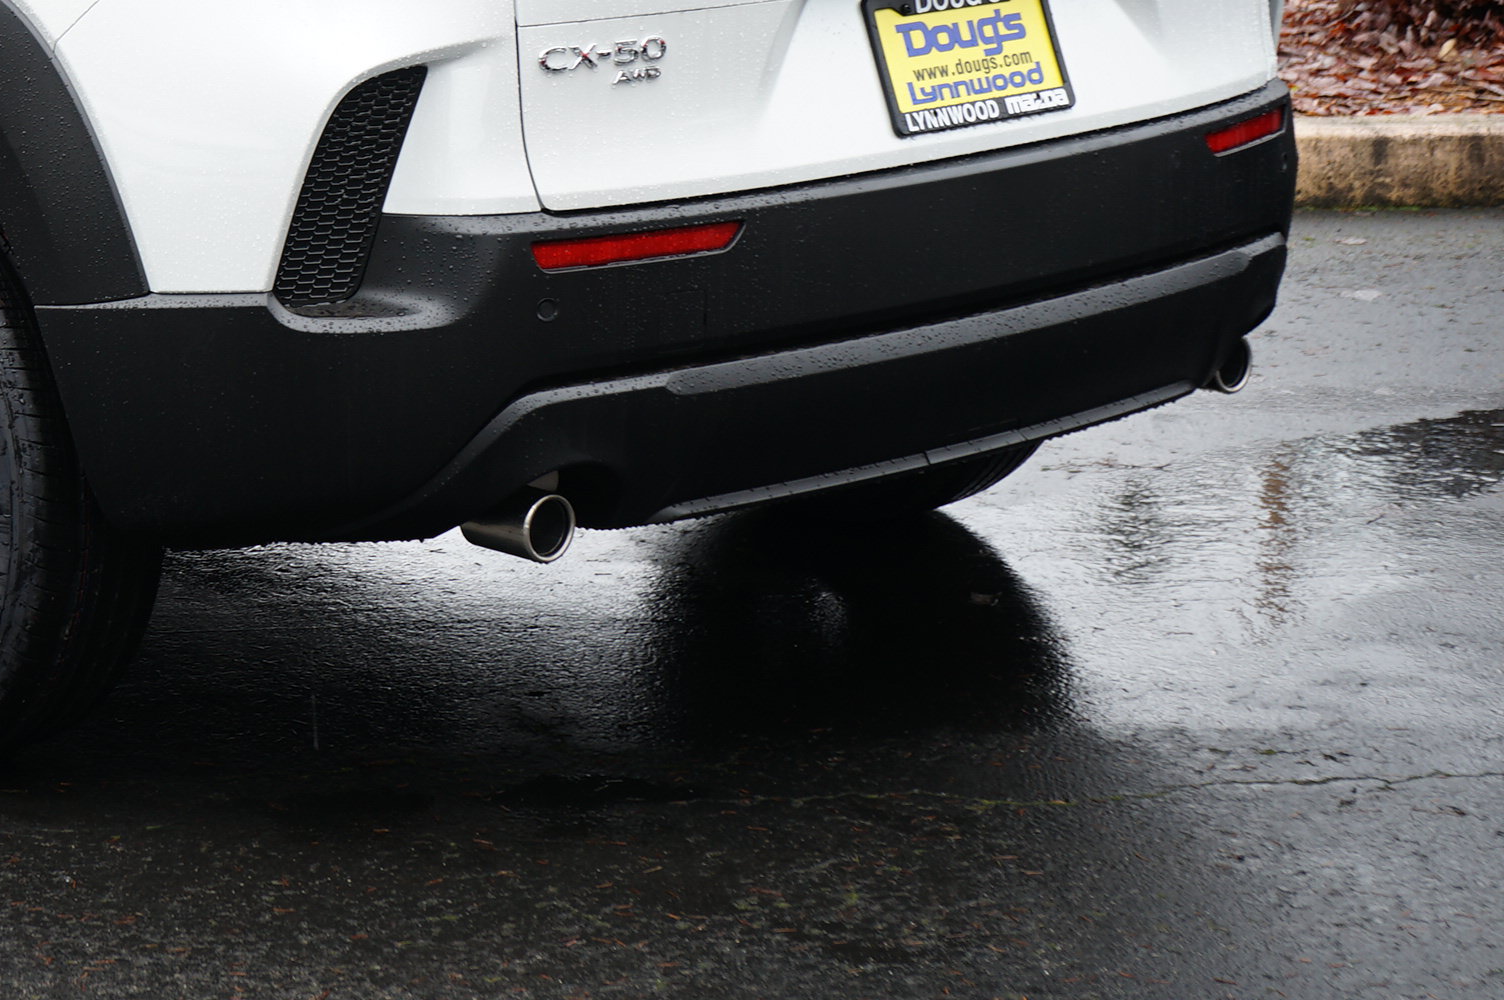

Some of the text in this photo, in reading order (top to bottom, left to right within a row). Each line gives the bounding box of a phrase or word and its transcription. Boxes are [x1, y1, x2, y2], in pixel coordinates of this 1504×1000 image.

[538, 35, 667, 72] CX-50
[912, 50, 1034, 82] www.dougs.com
[611, 66, 662, 85] AWD
[906, 61, 1044, 106] Lynnwood
[904, 99, 1000, 132] LYNNWOOD
